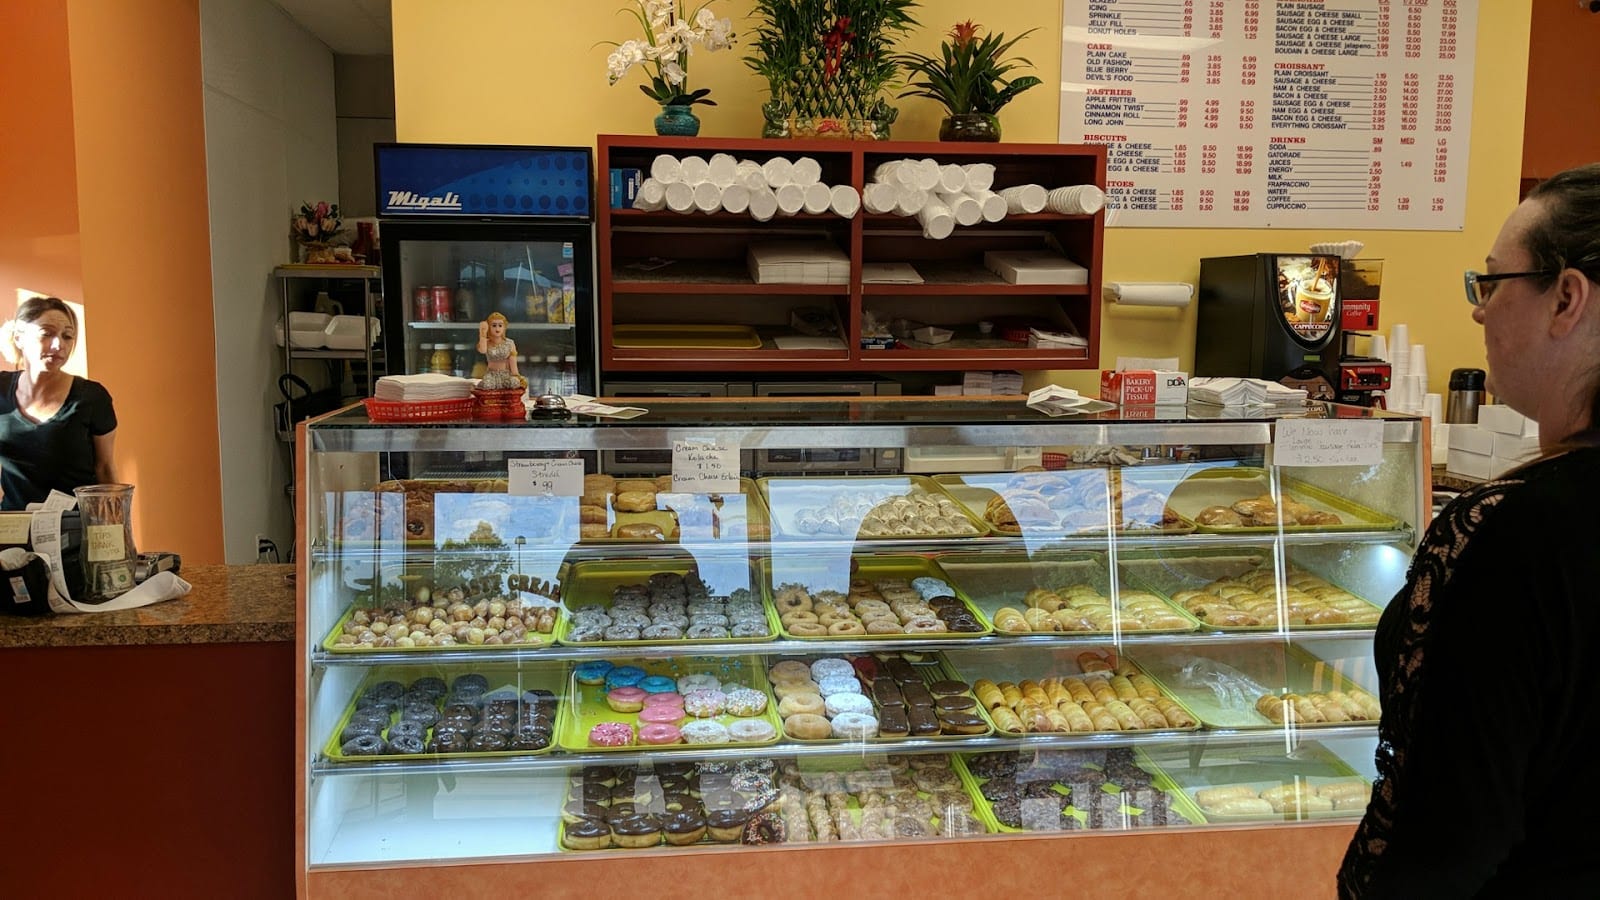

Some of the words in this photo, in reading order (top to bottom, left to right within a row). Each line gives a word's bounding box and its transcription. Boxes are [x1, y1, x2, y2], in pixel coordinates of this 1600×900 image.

[387, 191, 462, 210] Migali
[676, 444, 698, 452] Cream
[673, 474, 696, 482] Cream
